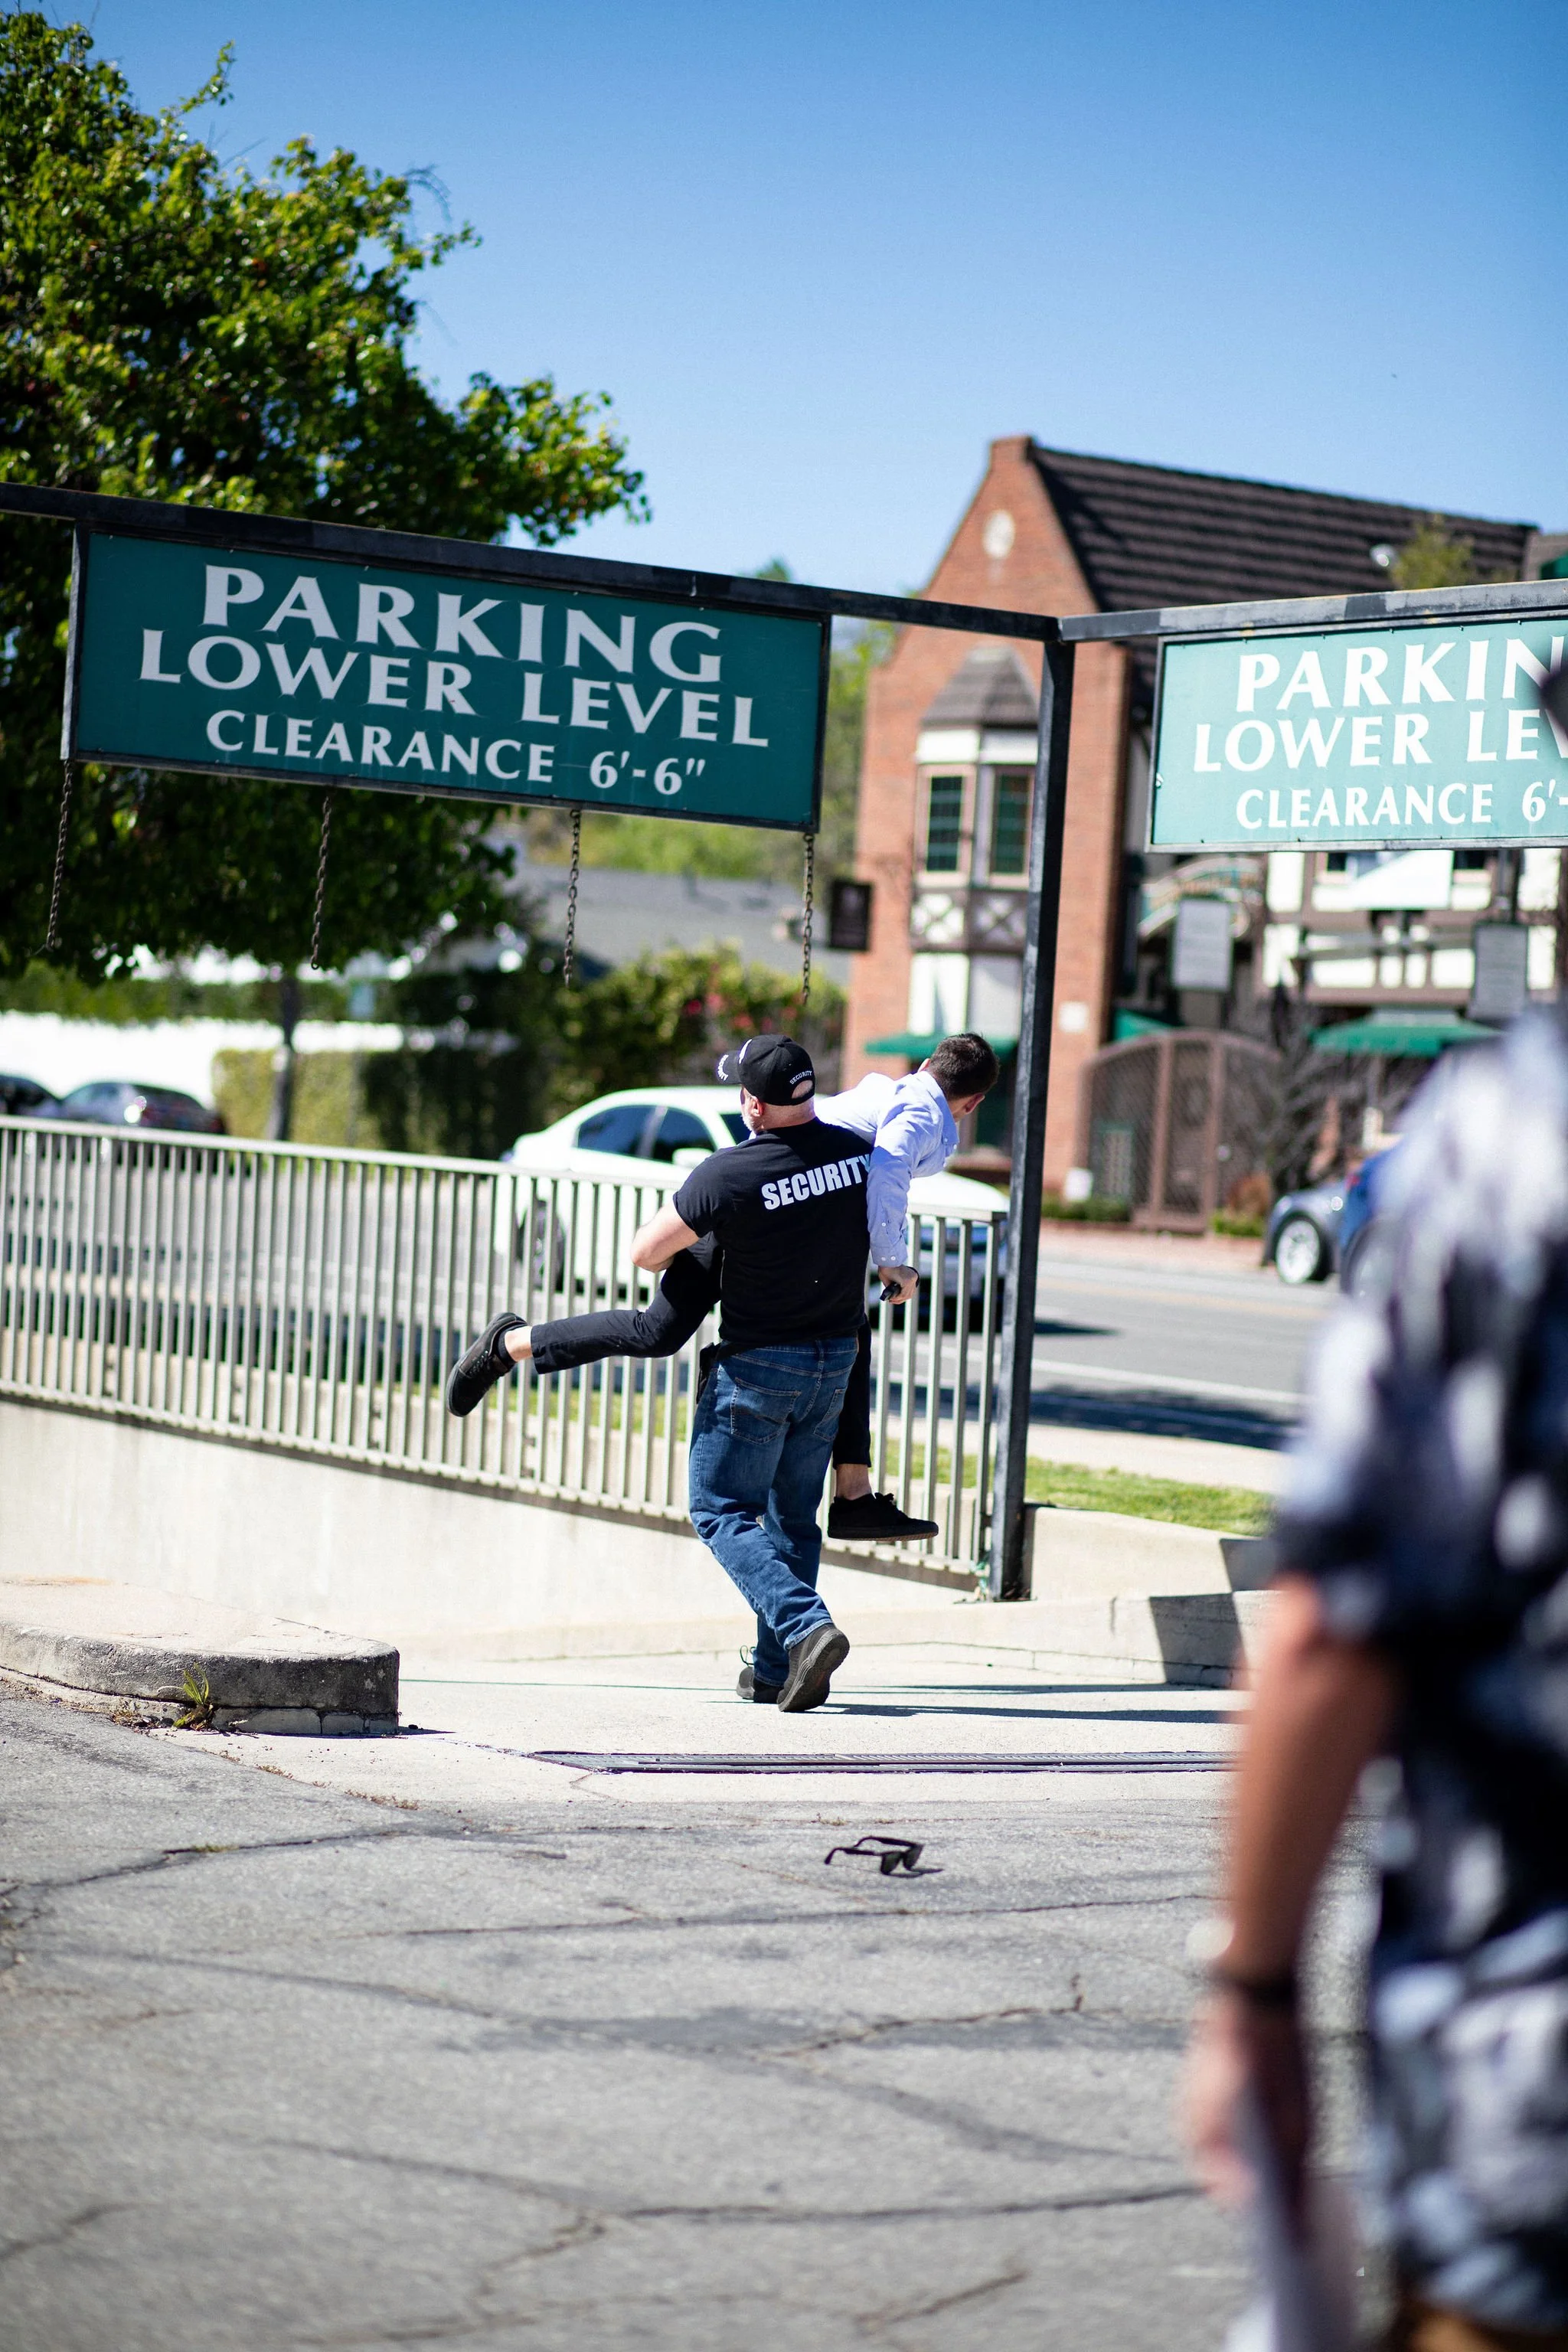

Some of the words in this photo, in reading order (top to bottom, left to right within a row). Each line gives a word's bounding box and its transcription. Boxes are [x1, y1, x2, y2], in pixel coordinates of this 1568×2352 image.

[202, 564, 722, 684] PARKING
[139, 629, 481, 716] LOWER
[521, 671, 769, 748] LEVEL
[206, 708, 556, 784] CLEARANCE
[590, 750, 707, 796] 6'-6"
[1194, 712, 1432, 773] LOWER
[1236, 782, 1494, 830] CLEARANCE
[789, 1070, 812, 1085] SECURITY
